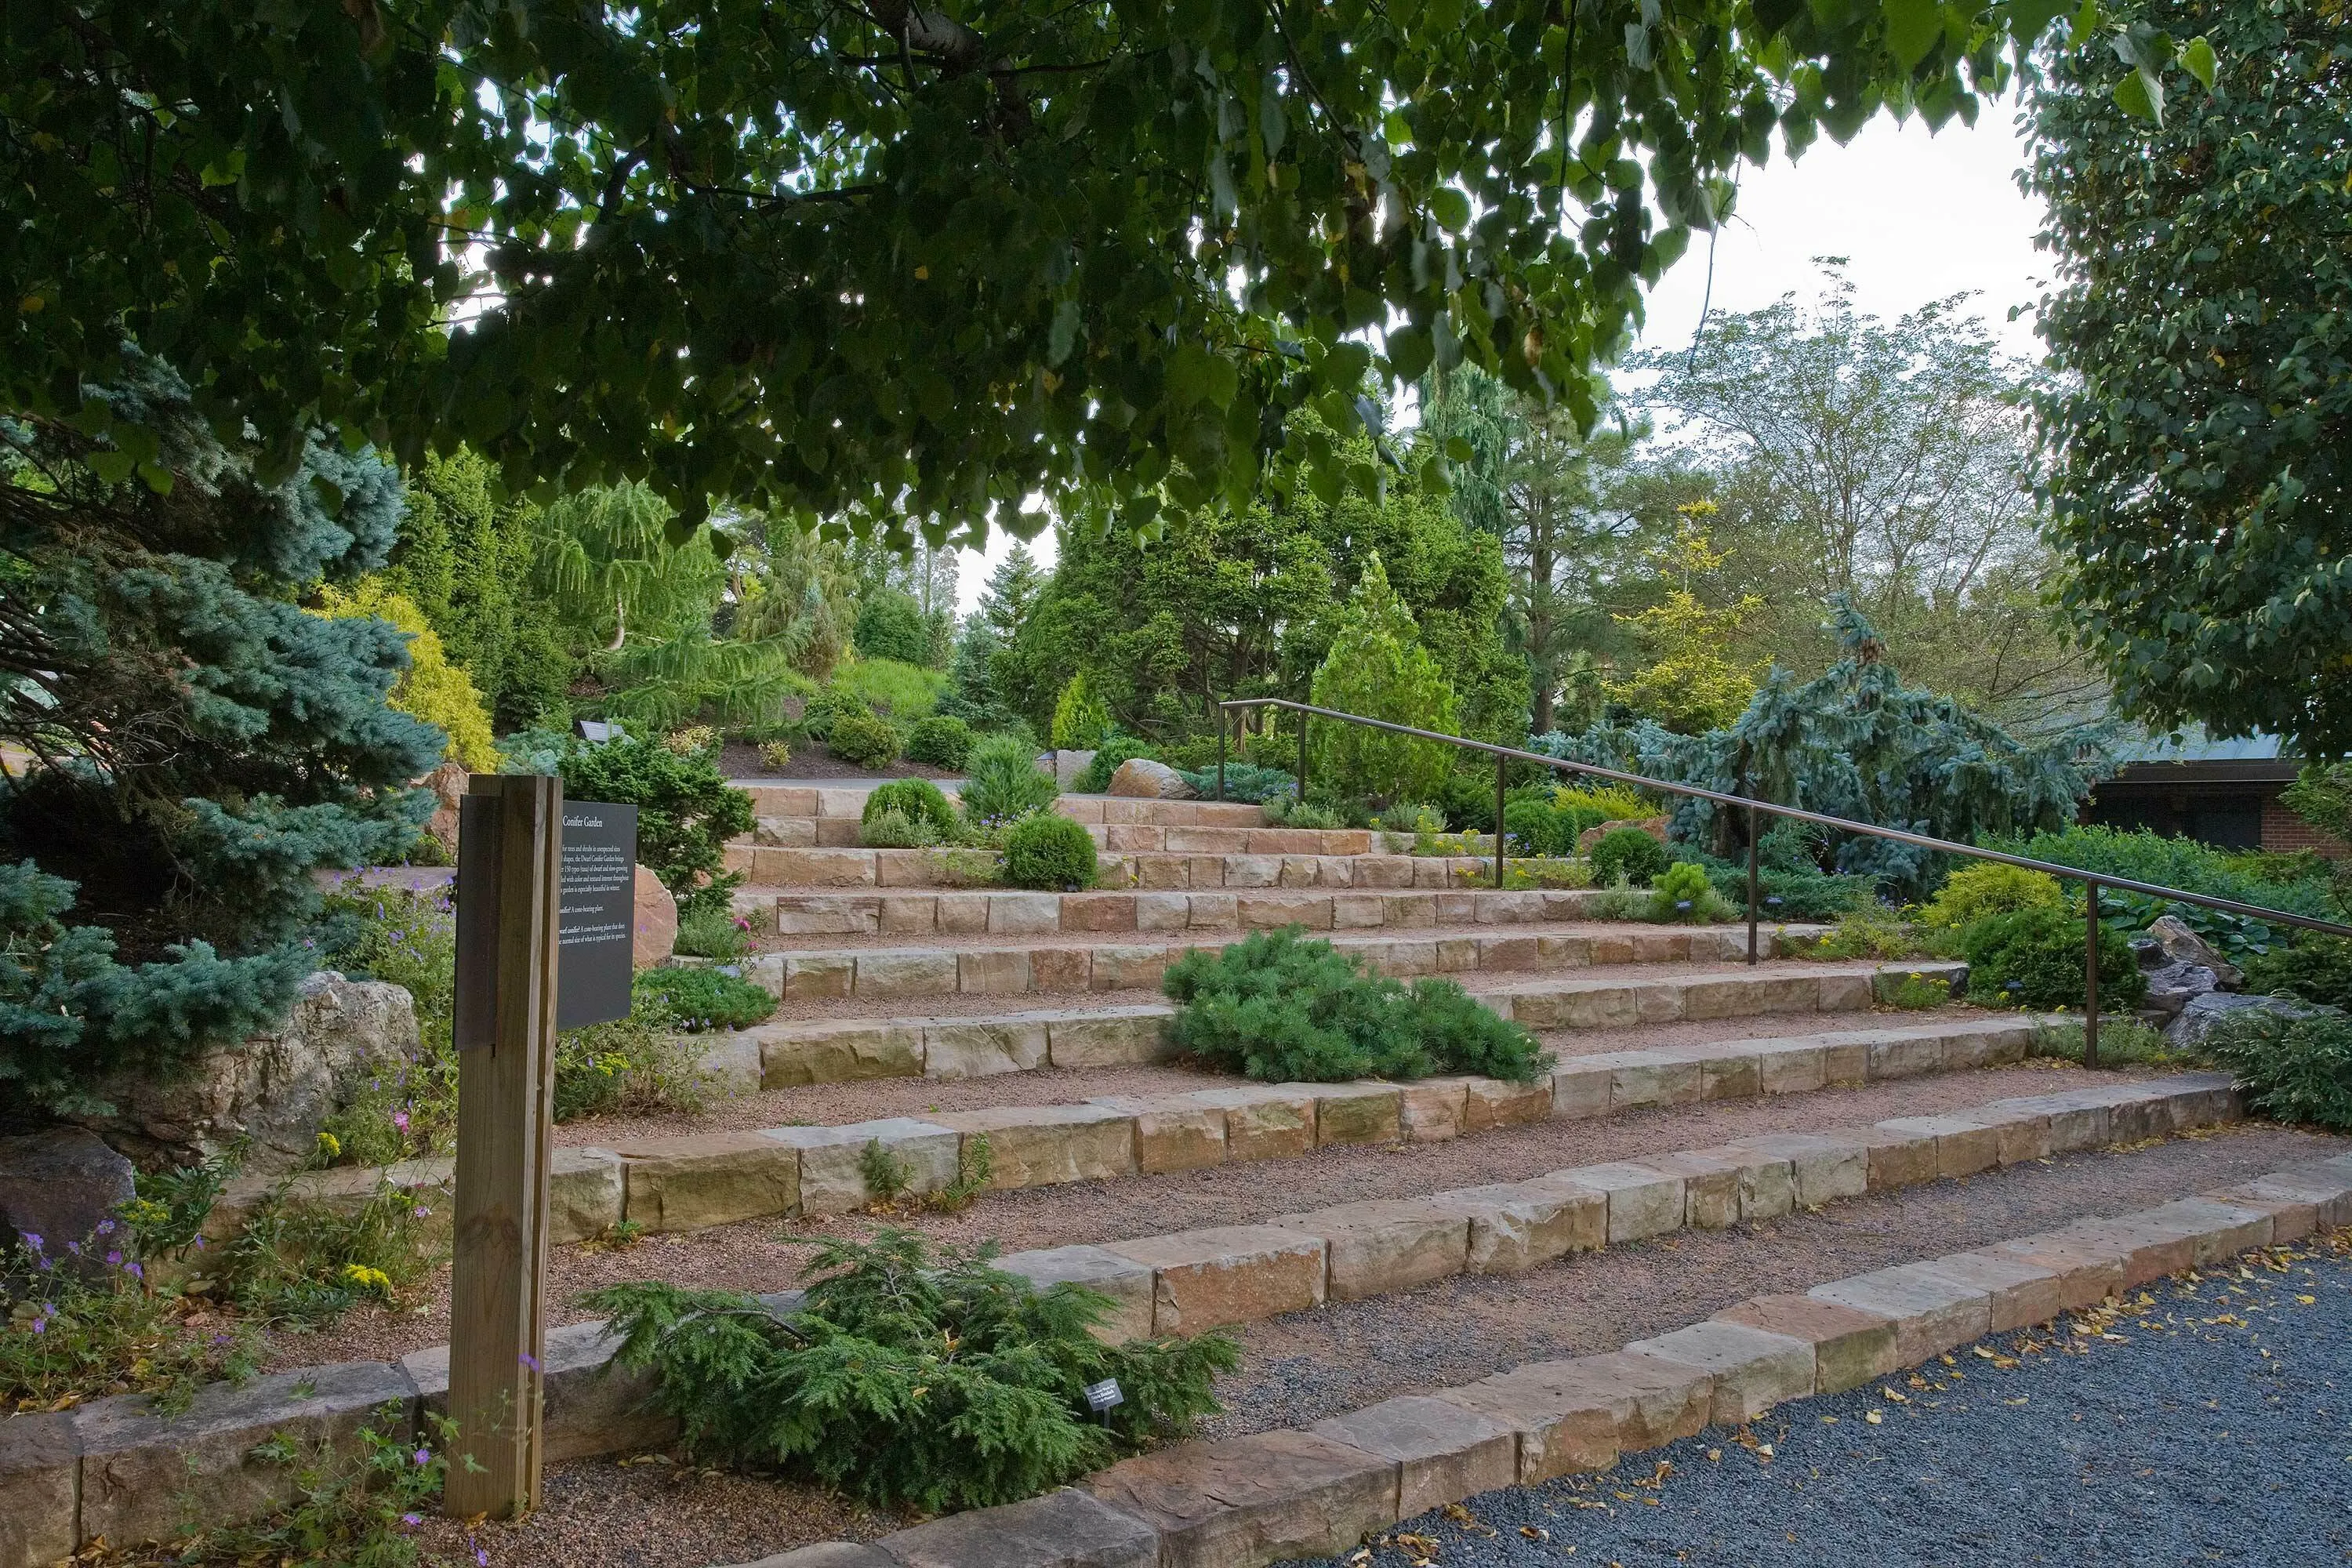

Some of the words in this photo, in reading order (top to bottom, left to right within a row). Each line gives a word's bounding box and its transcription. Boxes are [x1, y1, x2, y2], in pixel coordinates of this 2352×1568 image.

[563, 815, 583, 826] Conifer
[584, 816, 603, 827] Garden
[615, 855, 624, 863] brings
[577, 885, 592, 894] especially
[575, 905, 595, 914] cone-bearing
[584, 924, 603, 933] cone-bearing
[603, 924, 612, 933] plant
[562, 936, 574, 944] normal
